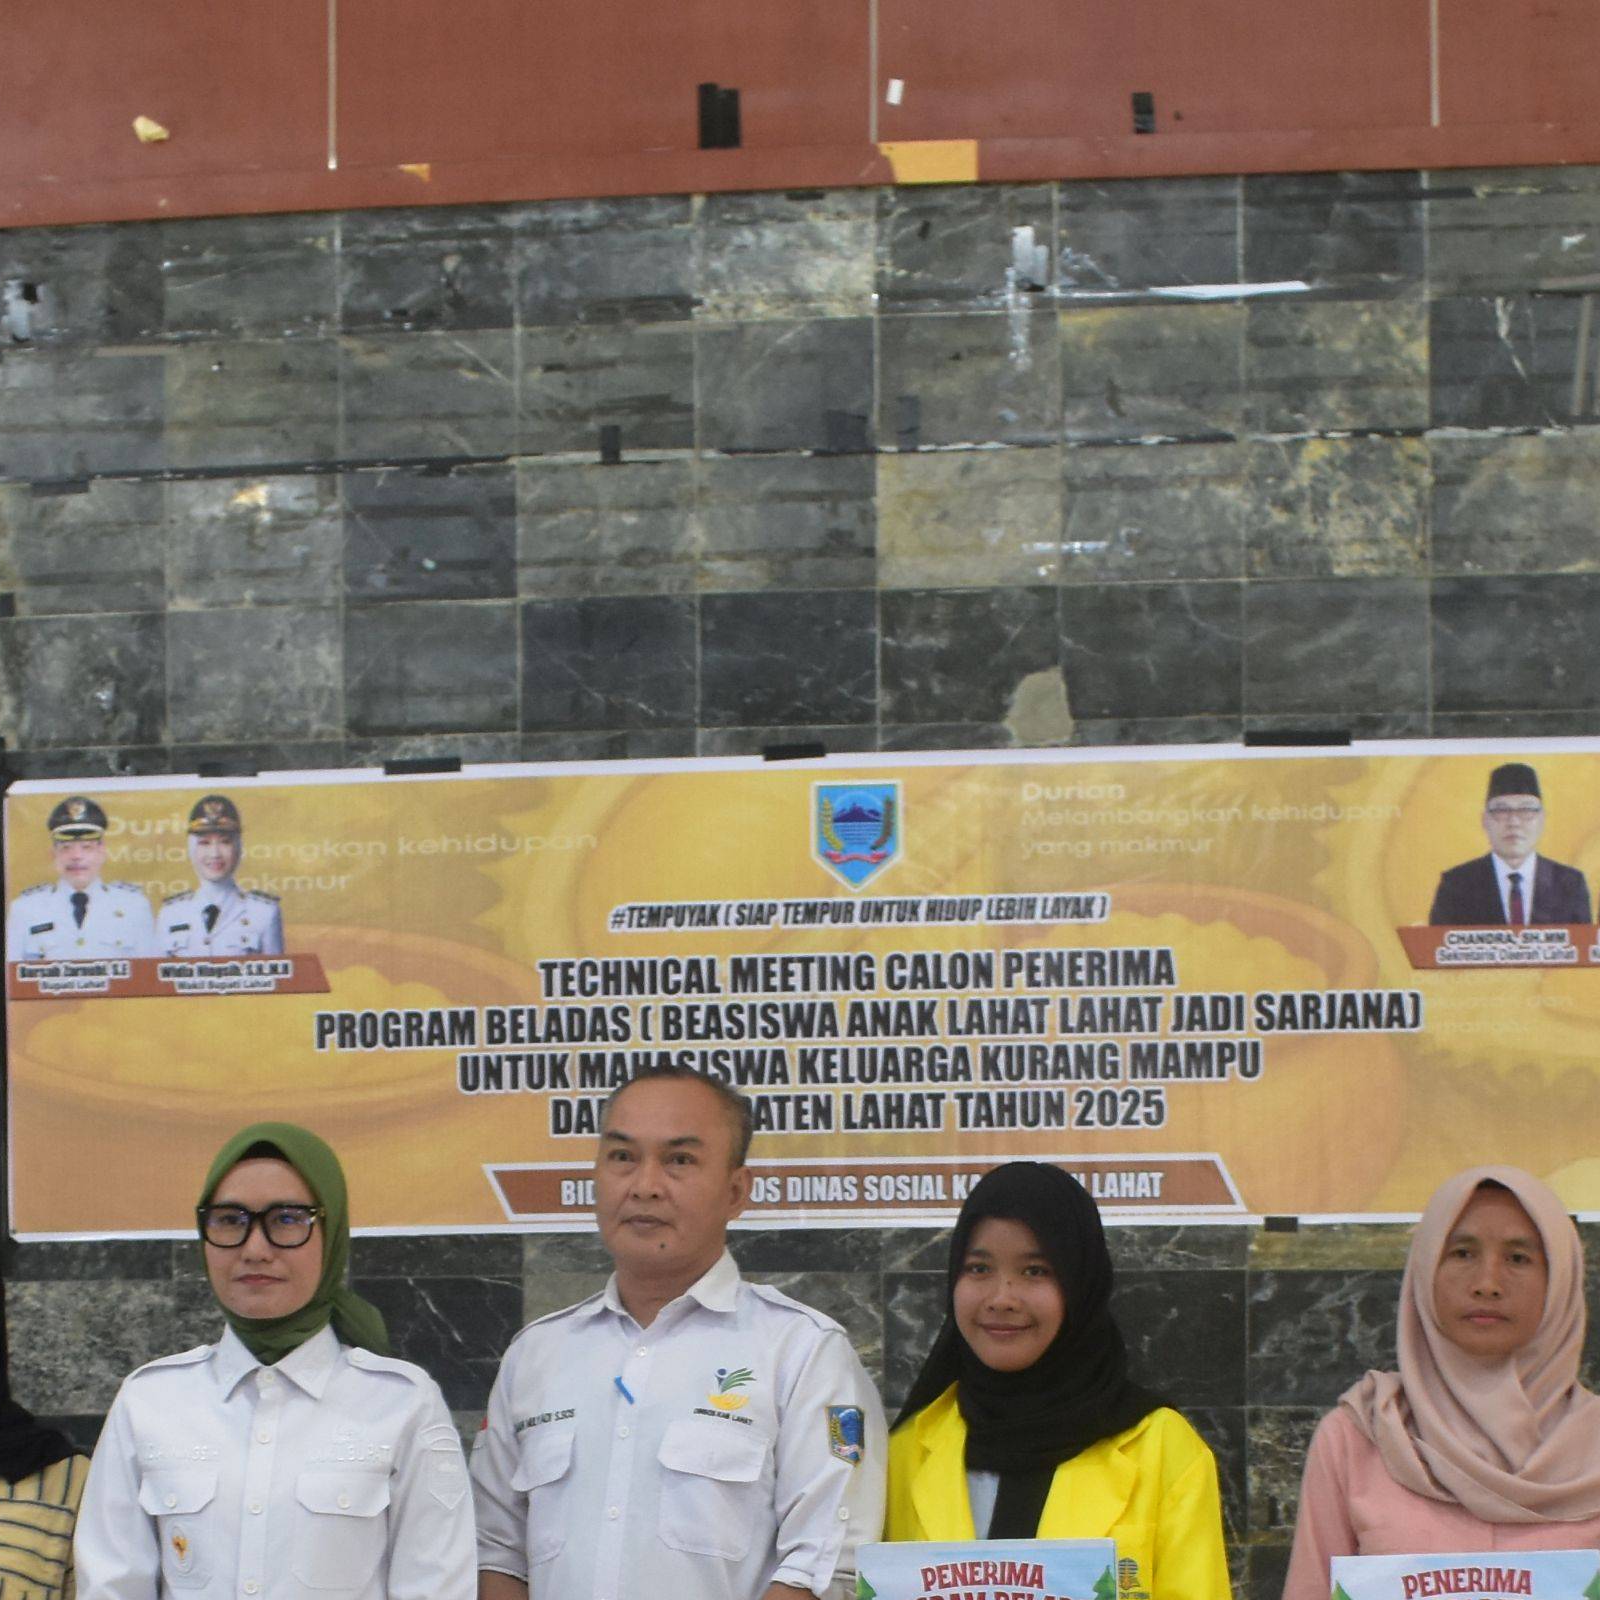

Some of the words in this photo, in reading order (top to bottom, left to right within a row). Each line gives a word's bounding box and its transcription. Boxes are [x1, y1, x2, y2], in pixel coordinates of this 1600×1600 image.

[1021, 783, 1126, 802] Durian
[1021, 801, 1243, 828] Melambangkan
[1252, 802, 1401, 823] kehidupan
[1021, 838, 1092, 859] yang
[1100, 835, 1215, 855] makmur
[611, 904, 718, 929] #TEMPUYAK
[736, 902, 777, 926] SIAP
[783, 900, 856, 924] TEMPUR
[860, 899, 922, 923] UNTUK
[925, 898, 982, 922] HIDUP
[987, 897, 1036, 921] LEBIH
[1041, 896, 1096, 920] LAYAK
[1499, 947, 1540, 961] Daerah
[1543, 947, 1576, 961] Lahat
[539, 957, 721, 998] TECHNICAL
[730, 953, 876, 993] MEETING
[885, 951, 993, 991] CALON
[1003, 949, 1175, 988] PENERIMA
[316, 1010, 476, 1050] PROGRAM
[486, 1006, 631, 1046] BELADAS
[663, 1001, 840, 1041] BEASISWA
[846, 1000, 938, 1038] ANAK
[948, 998, 1050, 1036] LAHAT
[1059, 996, 1163, 1034] LAHAT
[1171, 994, 1244, 1032] JADI
[1254, 991, 1422, 1030] SARJANA)
[460, 1054, 571, 1092] UNTUK
[799, 1045, 972, 1085] KELUARGA
[981, 1042, 1120, 1082] KURANG
[1130, 1041, 1261, 1079] MAMPU
[843, 1092, 946, 1130] LAHAT
[955, 1090, 1065, 1128] TAHUN
[1074, 1088, 1165, 1127] 2025
[786, 1175, 858, 1202] DINAS
[863, 1174, 948, 1201] SOSIAL
[1091, 1172, 1163, 1198] LAHAT
[921, 1561, 1045, 1592] PENERIMA
[1401, 1567, 1532, 1599] PENERIMA
